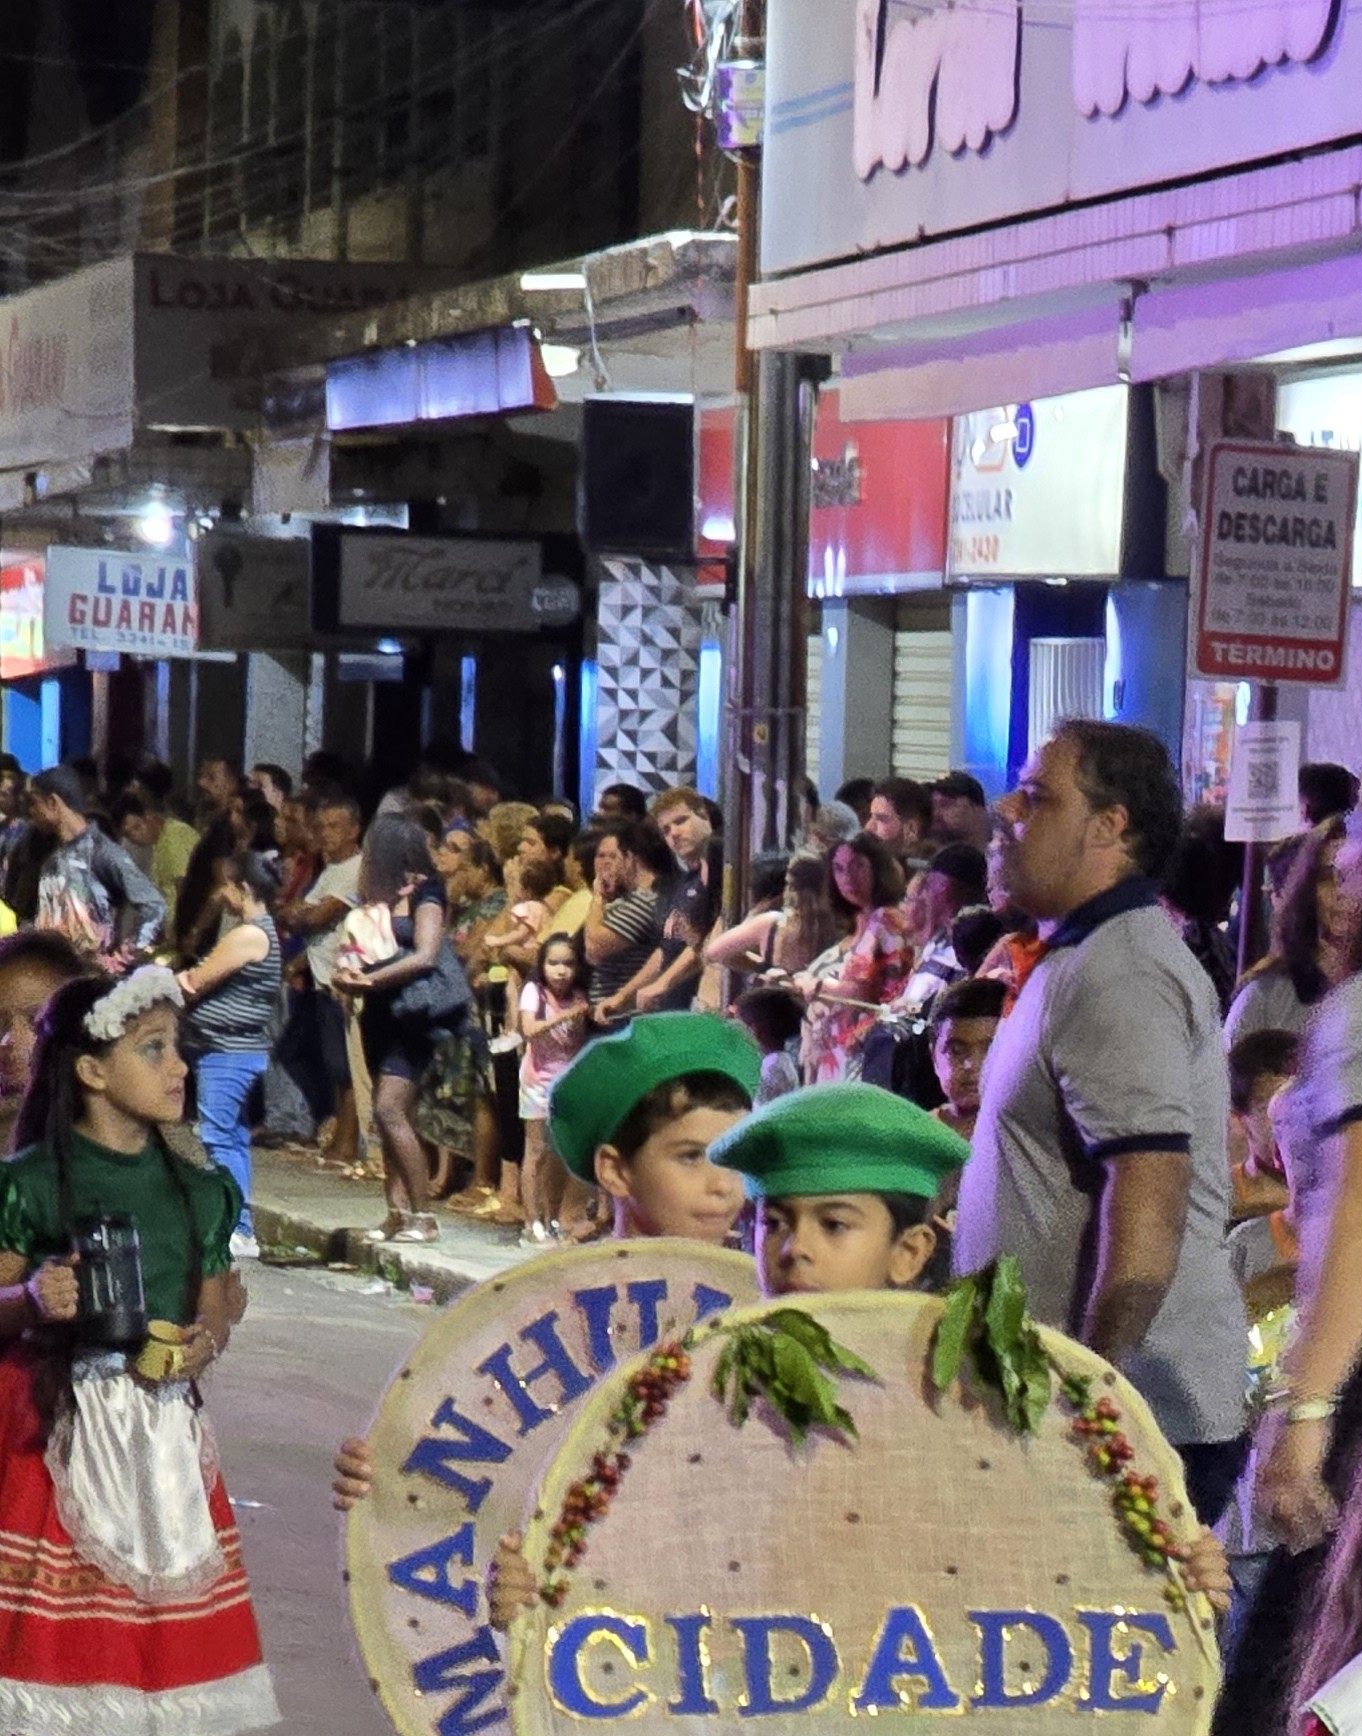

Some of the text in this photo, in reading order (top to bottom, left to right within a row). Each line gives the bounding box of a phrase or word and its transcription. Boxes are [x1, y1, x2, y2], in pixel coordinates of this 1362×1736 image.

[1232, 466, 1329, 504] CARGA E
[1216, 510, 1337, 549] DESCARGA
[97, 560, 188, 601] LOJA
[543, 1603, 1179, 1721] CIDADE
